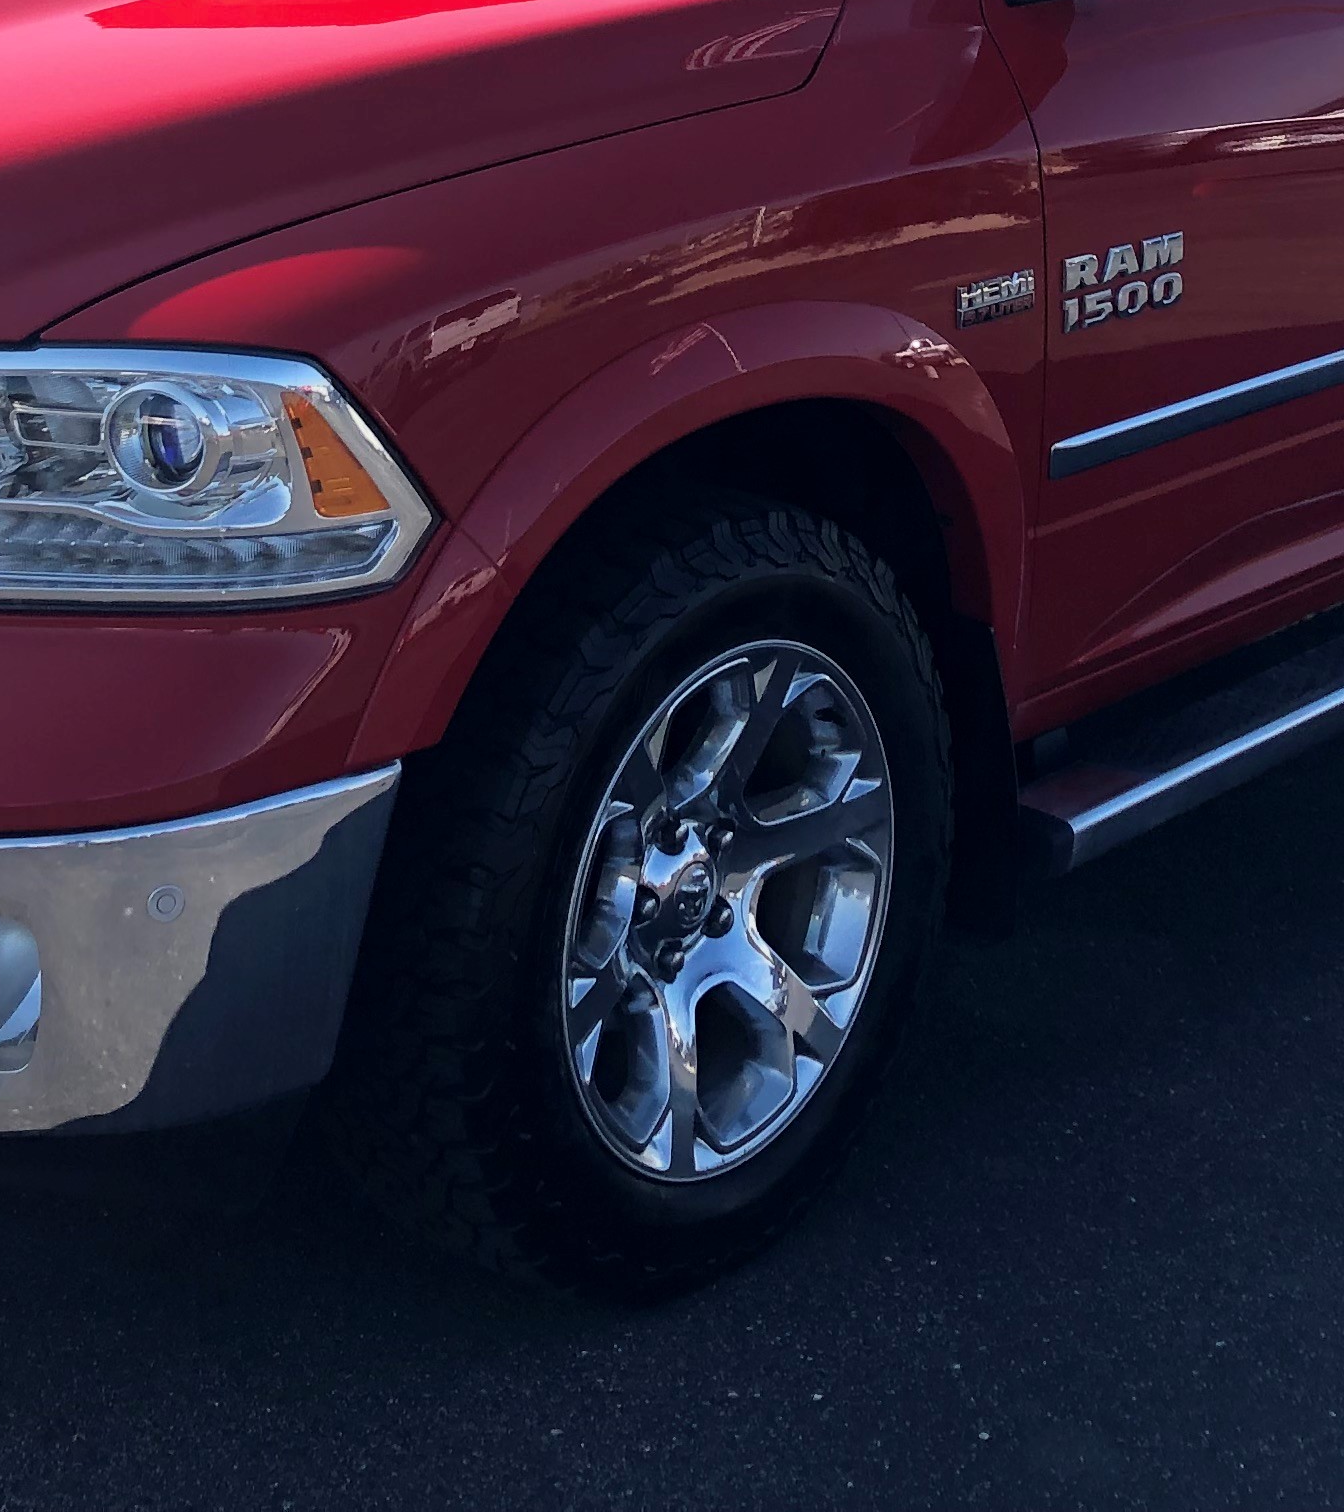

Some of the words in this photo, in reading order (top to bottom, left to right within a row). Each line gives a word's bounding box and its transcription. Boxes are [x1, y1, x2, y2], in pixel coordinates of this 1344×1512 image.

[957, 270, 1035, 307] HEMI
[1063, 231, 1184, 292] RAM
[1063, 272, 1183, 334] 1500
